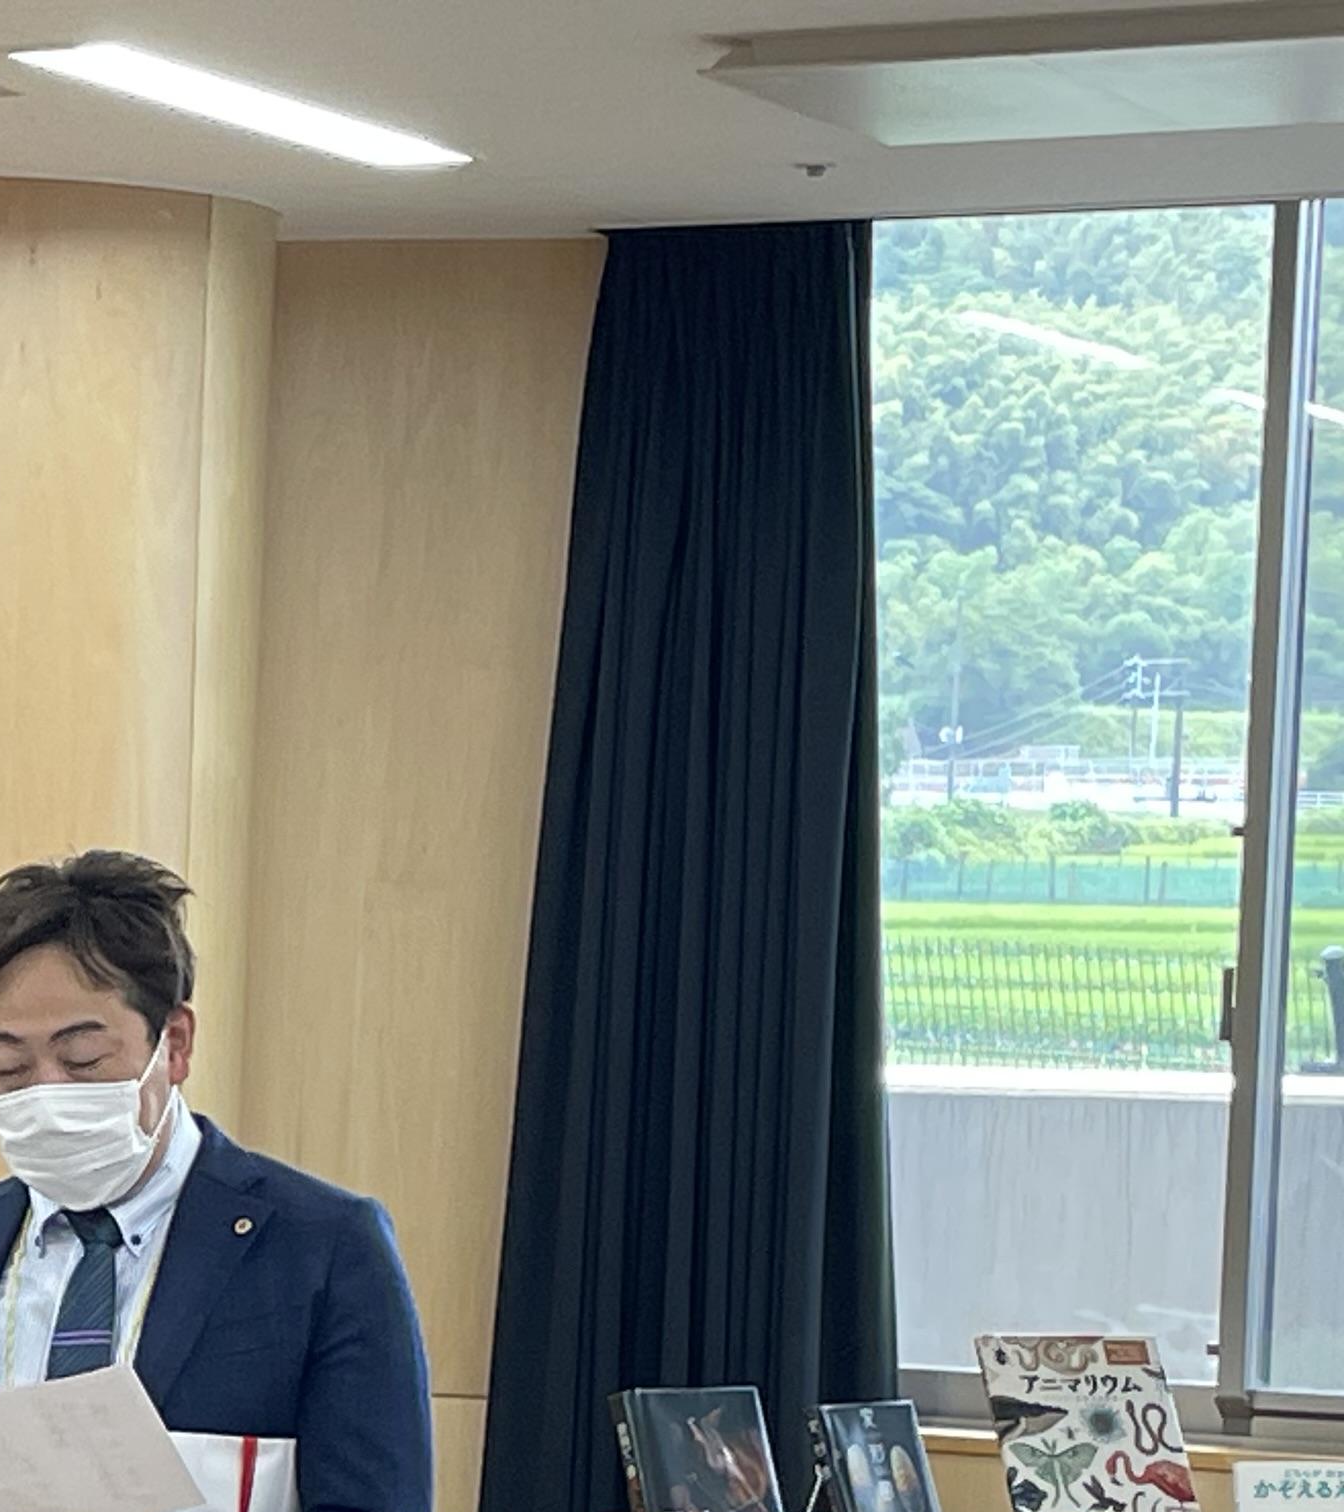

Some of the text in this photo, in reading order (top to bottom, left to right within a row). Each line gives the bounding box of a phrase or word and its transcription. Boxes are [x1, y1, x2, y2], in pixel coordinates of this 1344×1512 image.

[1019, 1374, 1143, 1396] アニマリウム
